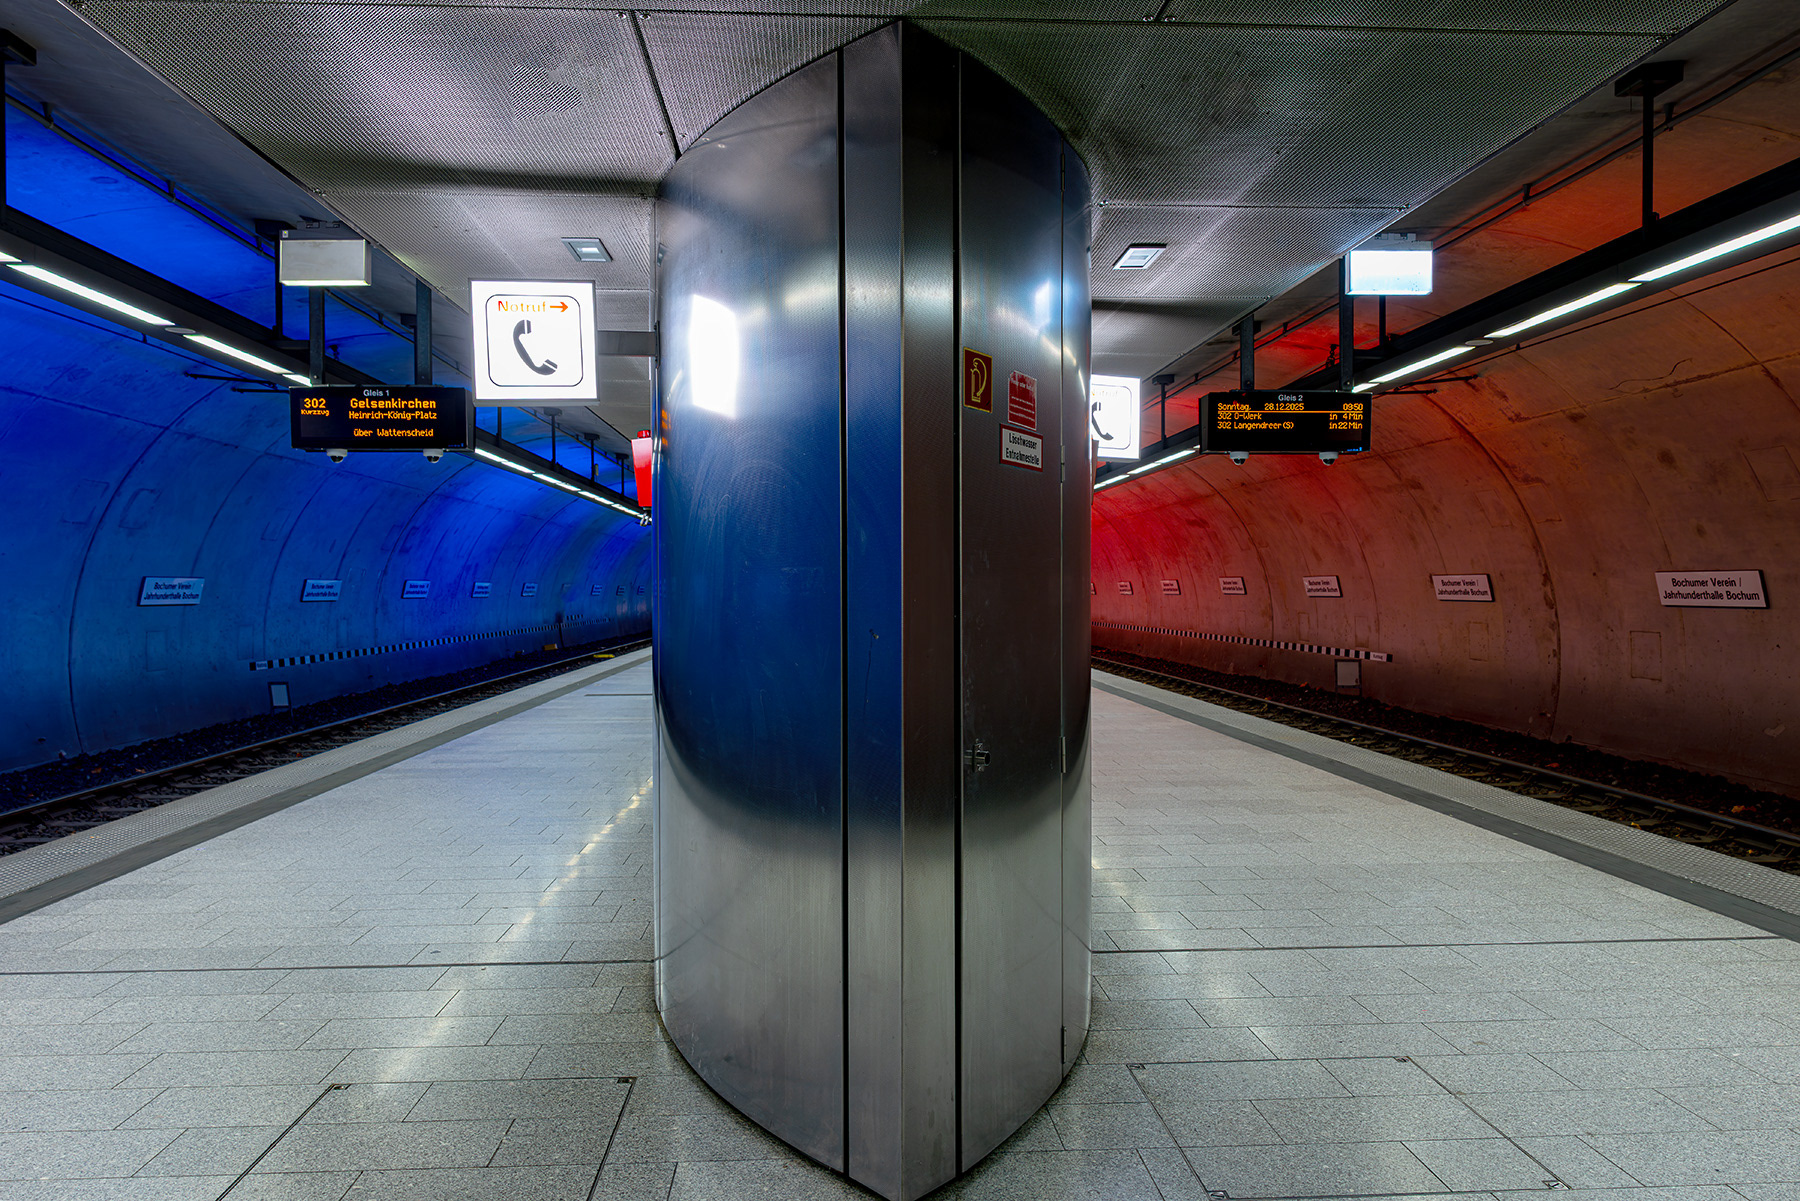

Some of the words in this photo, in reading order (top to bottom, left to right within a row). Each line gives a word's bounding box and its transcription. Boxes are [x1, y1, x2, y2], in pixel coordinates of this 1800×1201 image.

[497, 300, 546, 312] Notruf
[363, 389, 383, 397] Gleis
[385, 389, 390, 397] 1
[1278, 394, 1297, 402] Gleis
[1298, 394, 1304, 402] 2
[304, 398, 326, 409] 302
[350, 398, 437, 409] Gelsenkirchen
[1264, 402, 1305, 411] 28.12.2025
[300, 409, 330, 417] Kurzzug
[348, 410, 438, 421] Heinrich-König-Platz
[1217, 412, 1232, 420] 302
[1329, 412, 1338, 420] in
[1342, 412, 1348, 420] 4
[1348, 412, 1364, 420] Min
[1217, 421, 1232, 430] 302
[1233, 421, 1282, 431] Langendreer
[1282, 421, 1295, 430] (S)
[1329, 421, 1338, 430] in
[1338, 421, 1348, 430] 22
[1348, 421, 1363, 430] Min
[353, 428, 374, 437] über
[376, 428, 434, 437] Wattenscheid
[153, 581, 178, 590] Bochumer
[177, 581, 192, 590] Verein
[1441, 579, 1461, 587] Bochumer
[1461, 579, 1476, 587] Verein
[1671, 577, 1709, 587] Bochumer
[1710, 577, 1737, 587] Verein
[143, 591, 182, 600] Jahrhunderthalle
[181, 591, 200, 600] Bochum
[1663, 590, 1725, 600] Jahrhunderthalle
[1725, 590, 1760, 601] Bochum
